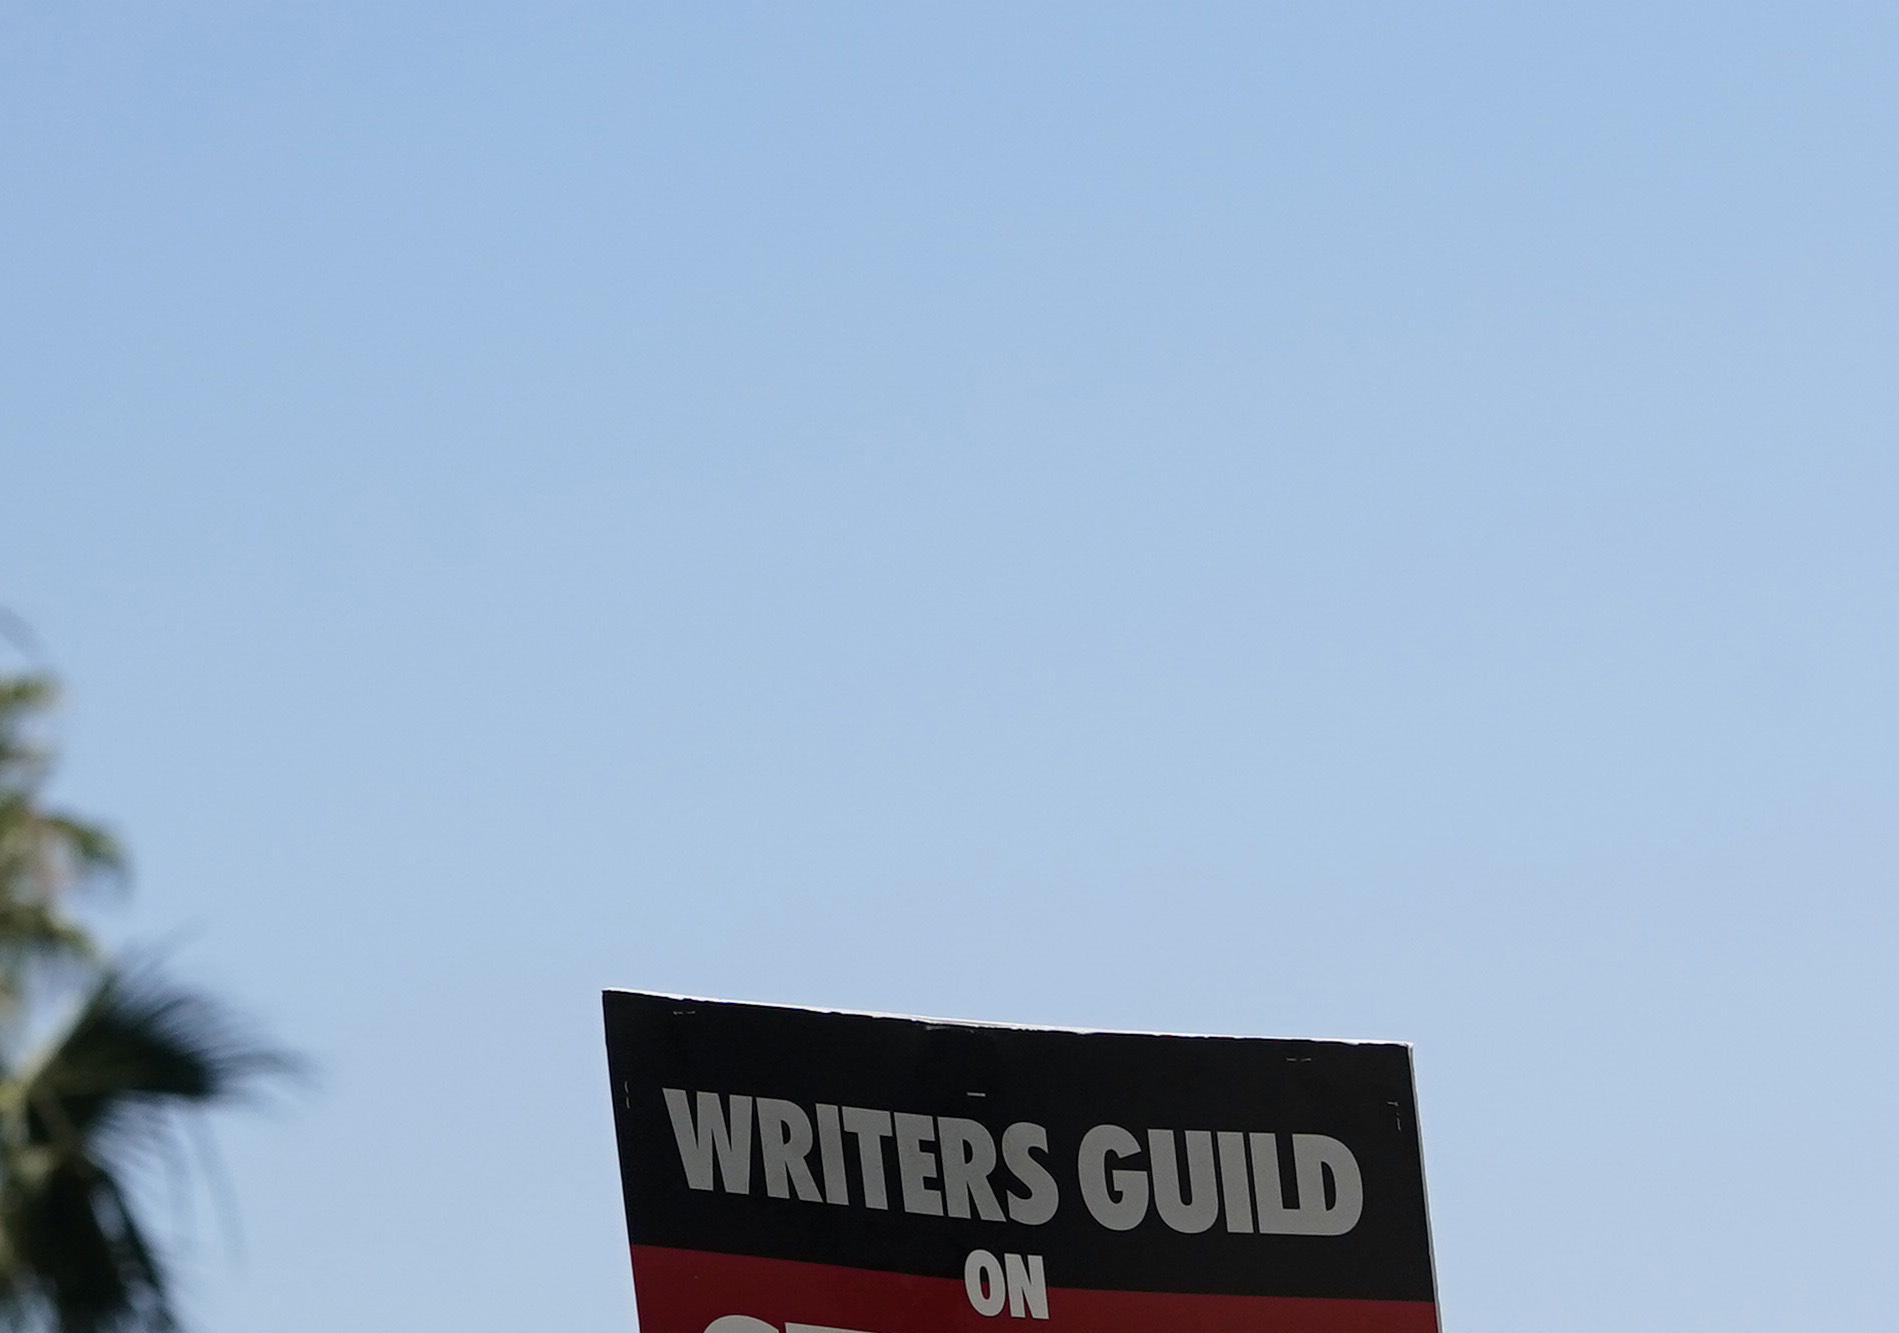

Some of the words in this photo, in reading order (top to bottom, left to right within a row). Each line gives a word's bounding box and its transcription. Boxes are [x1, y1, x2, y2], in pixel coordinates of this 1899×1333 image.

[663, 1088, 1059, 1227] WRITERS
[1077, 1124, 1364, 1237] GUILD
[963, 1249, 1050, 1320] ON
